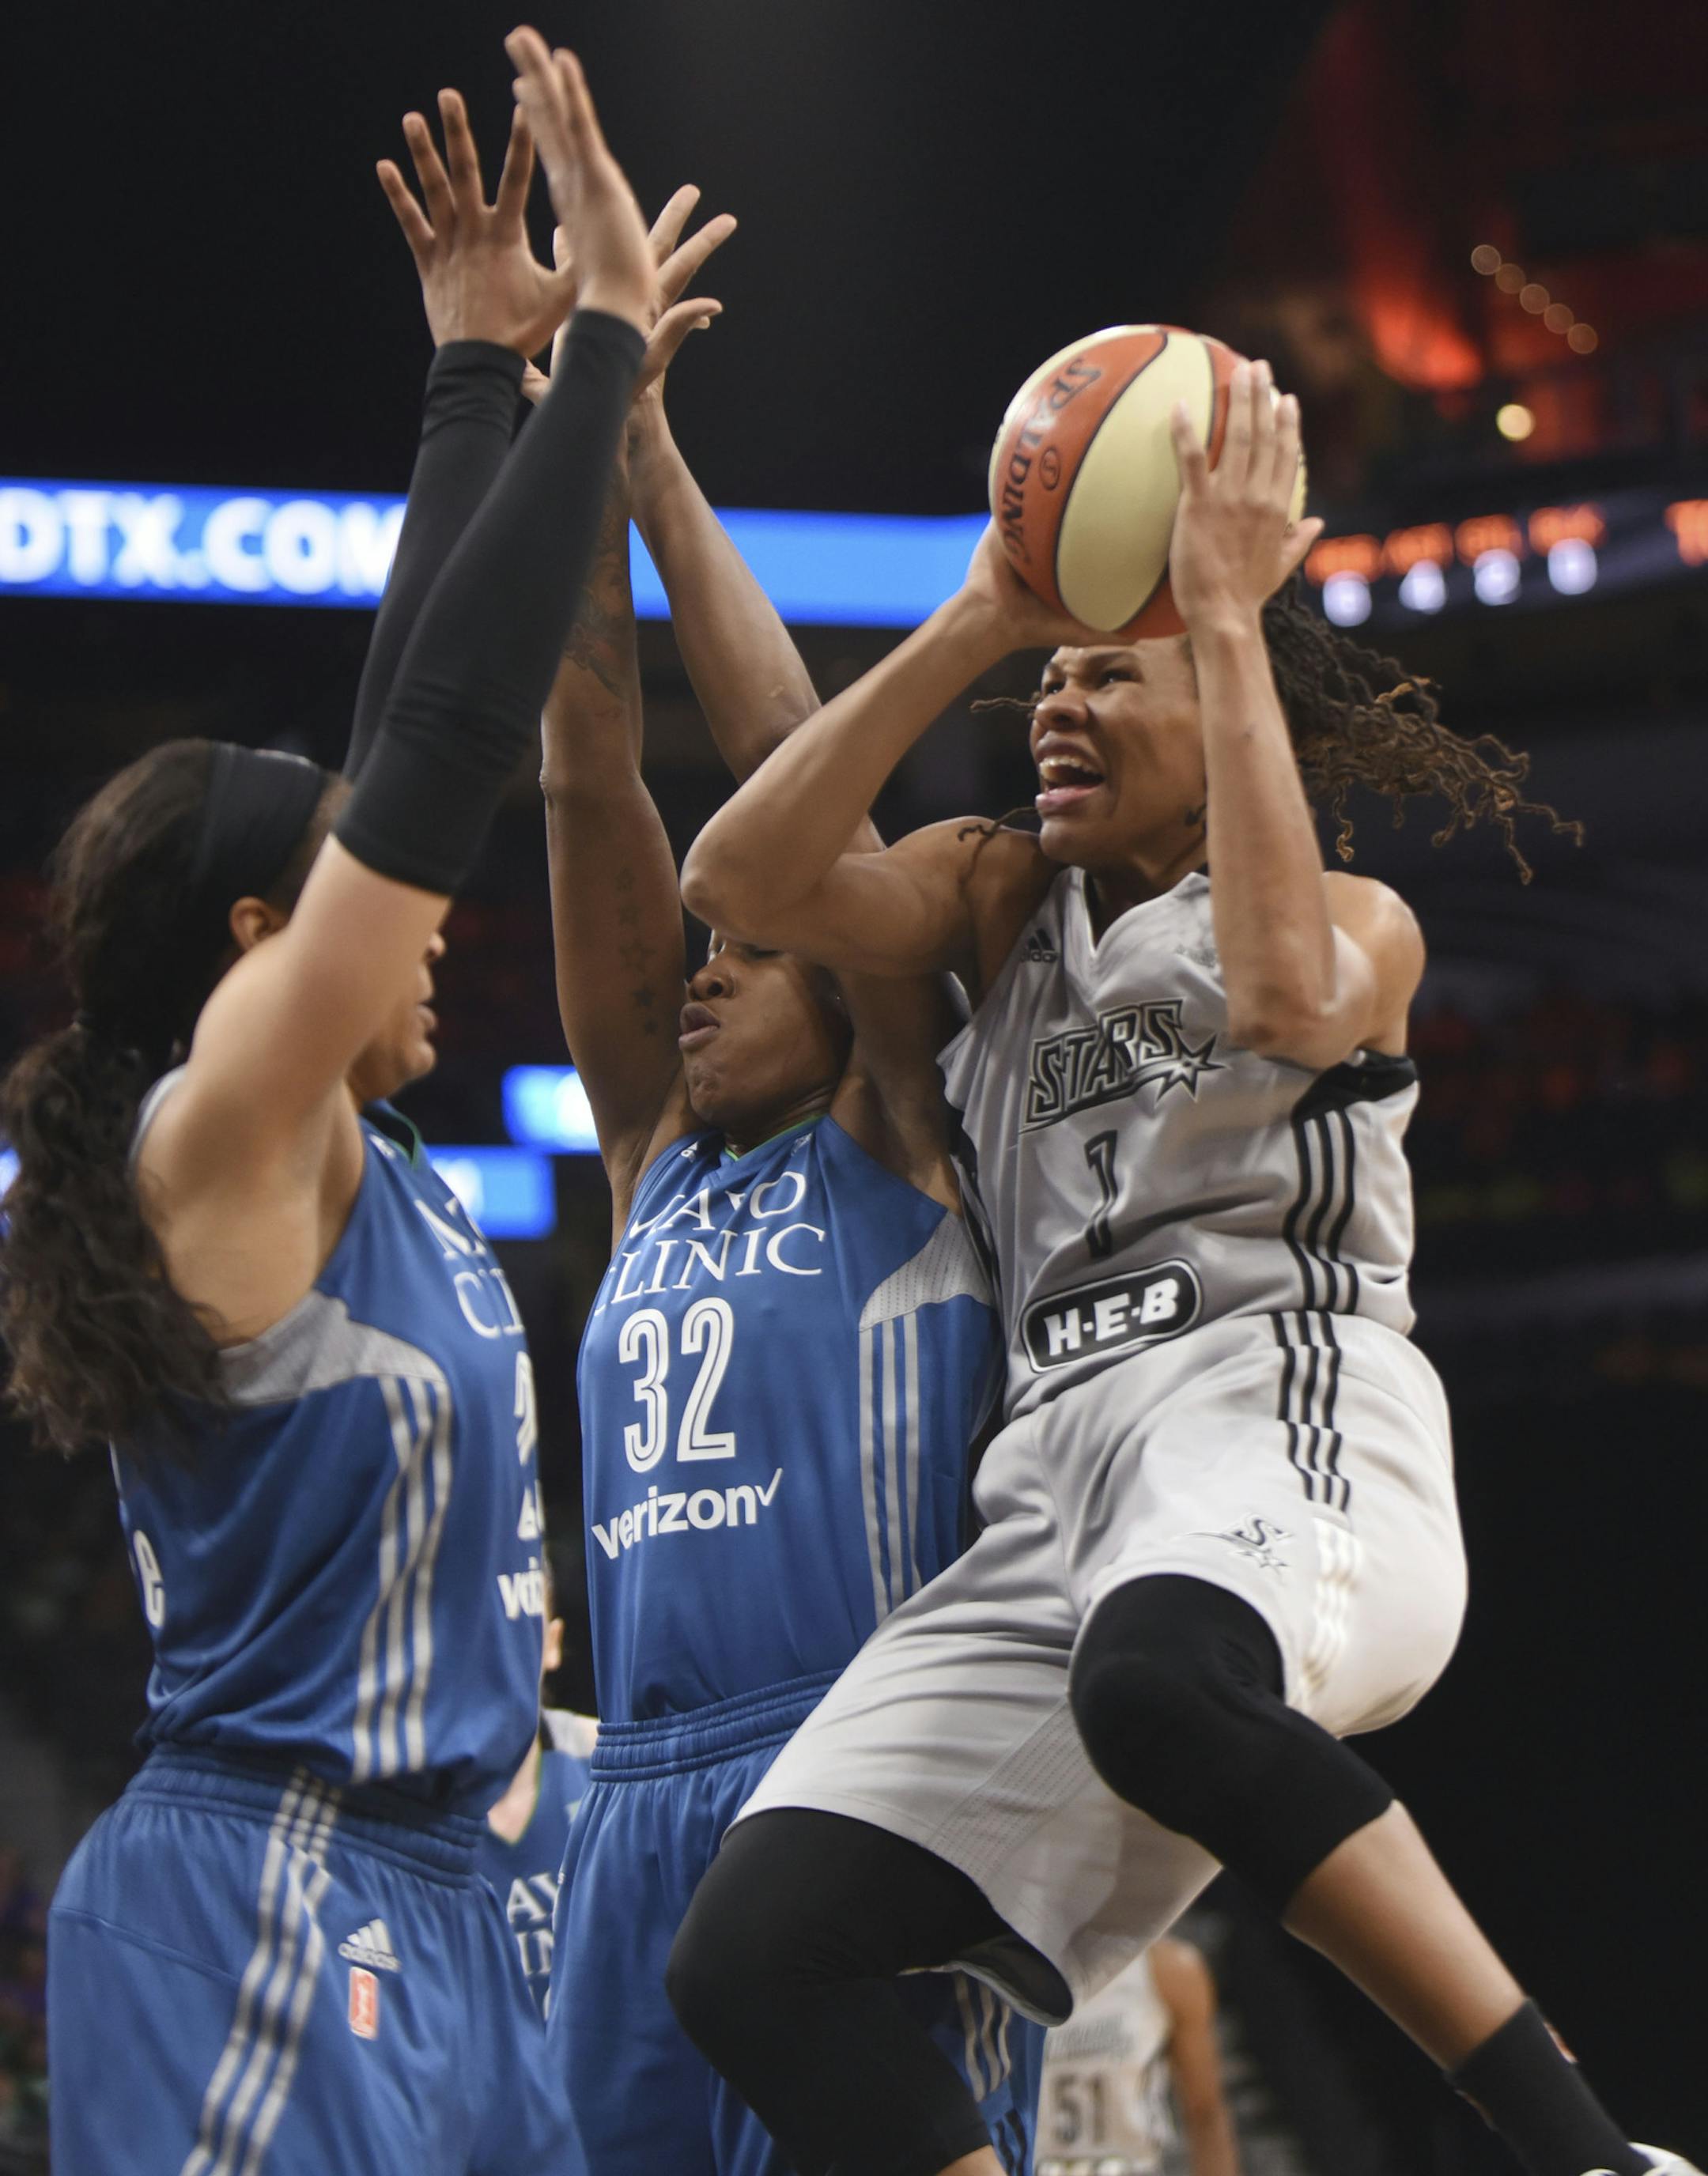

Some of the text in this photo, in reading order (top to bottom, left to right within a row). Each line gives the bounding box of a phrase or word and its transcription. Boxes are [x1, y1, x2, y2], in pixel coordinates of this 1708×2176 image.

[1026, 997, 1185, 1124] STARS
[595, 1222, 826, 1316] LINIC
[618, 1297, 736, 1473] 32
[591, 1486, 758, 1560] verizon
